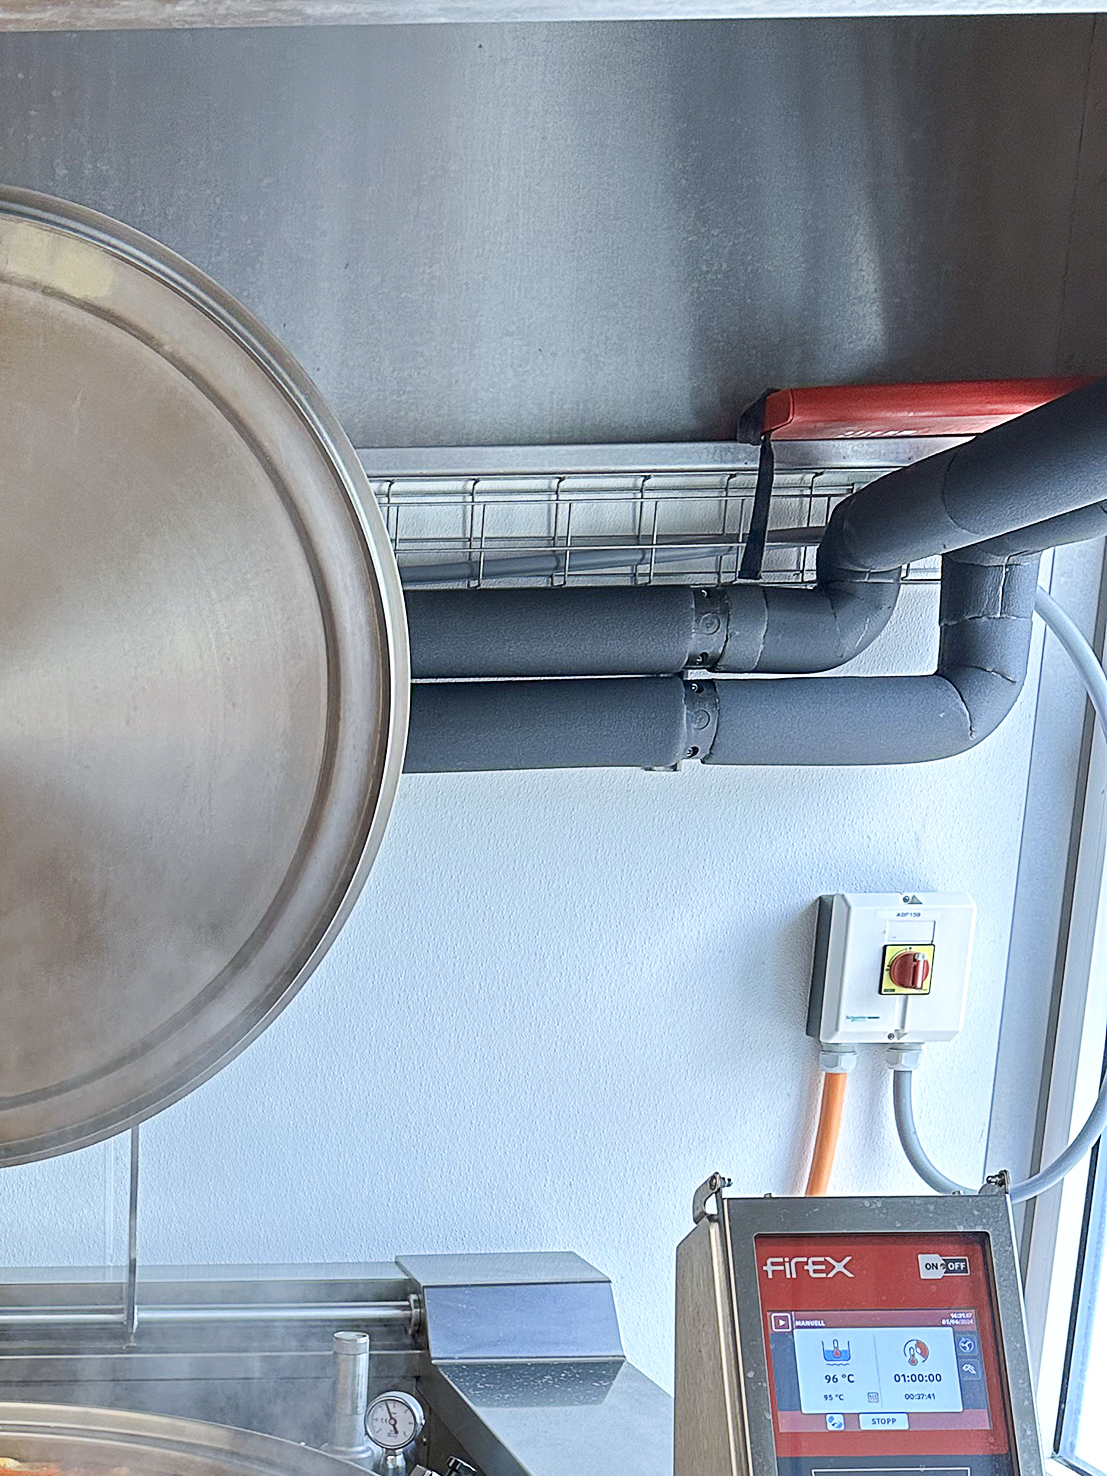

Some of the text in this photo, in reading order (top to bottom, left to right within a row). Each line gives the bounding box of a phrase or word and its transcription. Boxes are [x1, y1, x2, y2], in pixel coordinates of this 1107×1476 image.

[924, 1261, 966, 1271] ON OFF
[824, 1373, 839, 1384] 96
[893, 1373, 943, 1383] 01:00:00
[823, 1393, 834, 1401] 95
[904, 1393, 936, 1401] 00:37:41
[871, 1417, 897, 1426] STOPP
